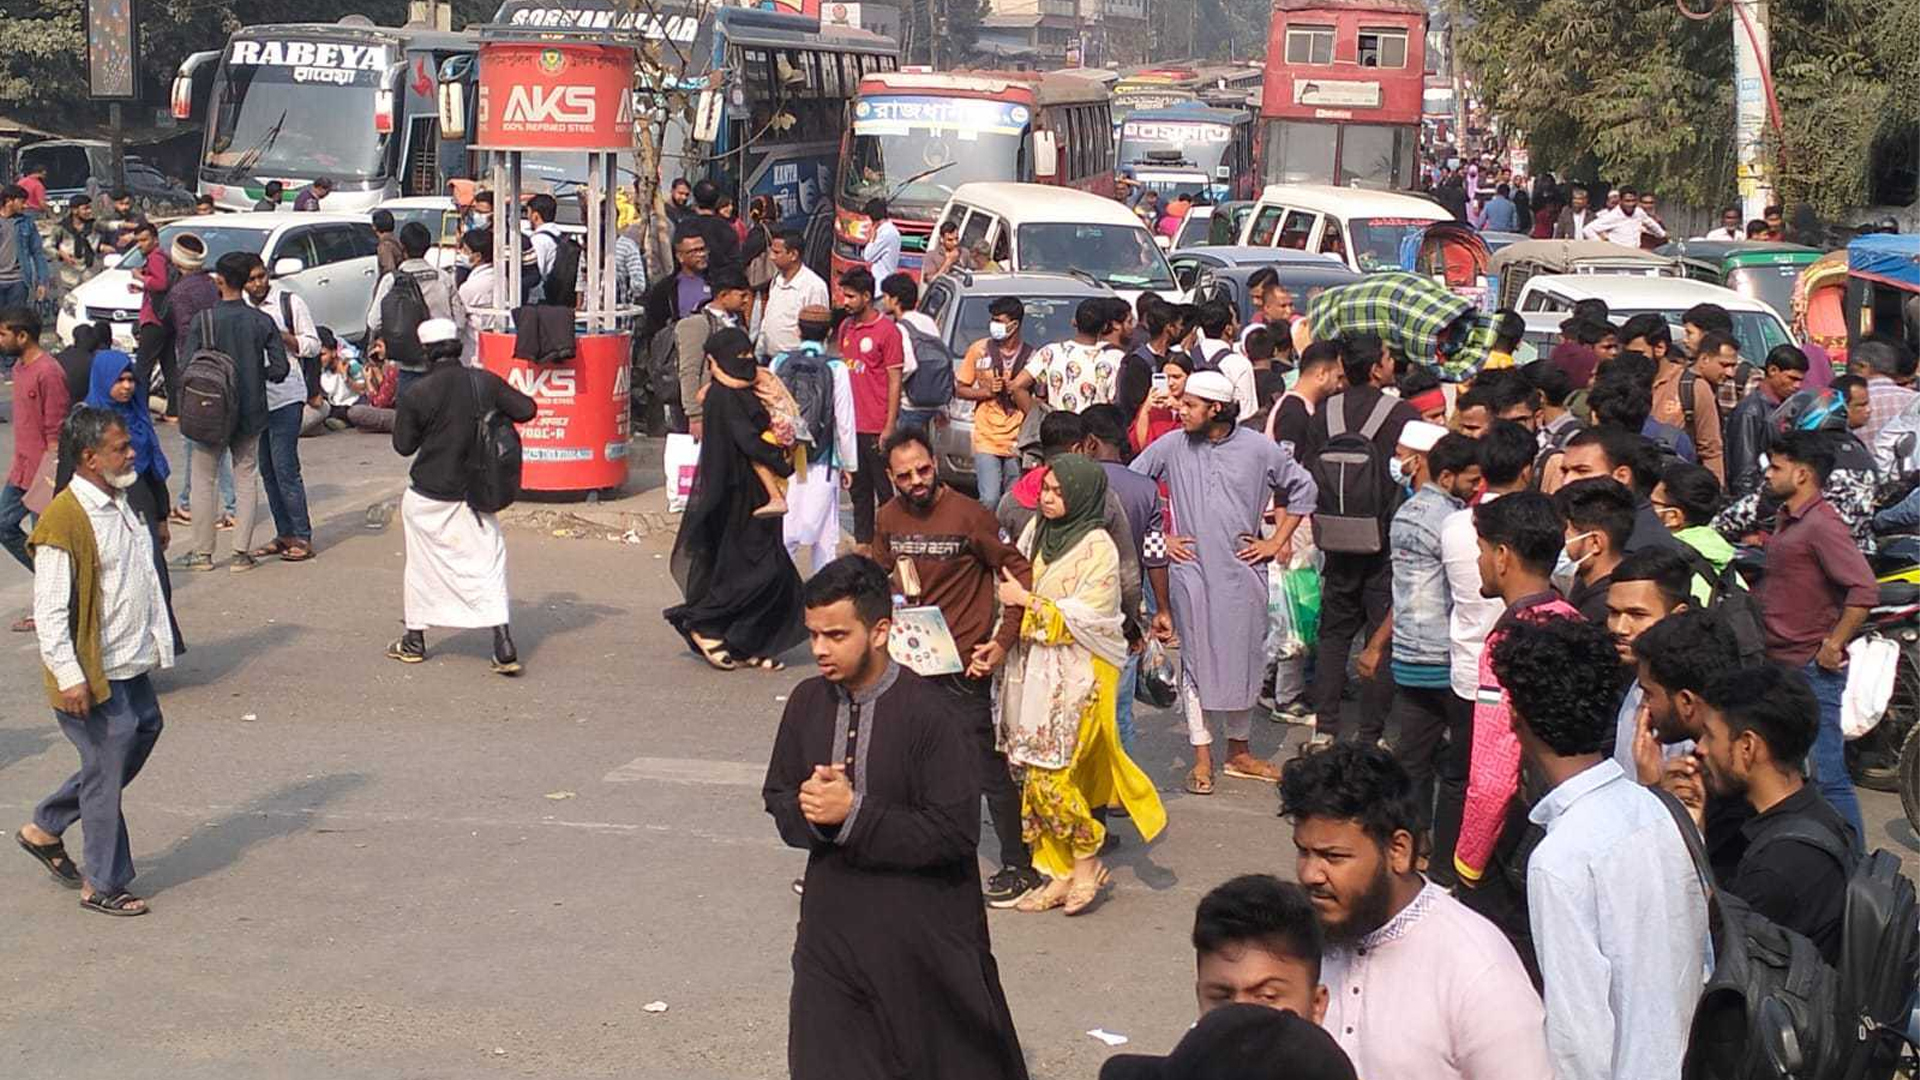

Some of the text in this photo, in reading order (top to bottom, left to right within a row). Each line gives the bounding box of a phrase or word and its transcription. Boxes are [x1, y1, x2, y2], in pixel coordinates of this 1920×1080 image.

[230, 41, 388, 71] RABEYA
[503, 85, 596, 122] AKS
[568, 123, 596, 133] STEEL
[508, 367, 576, 397] AKS
